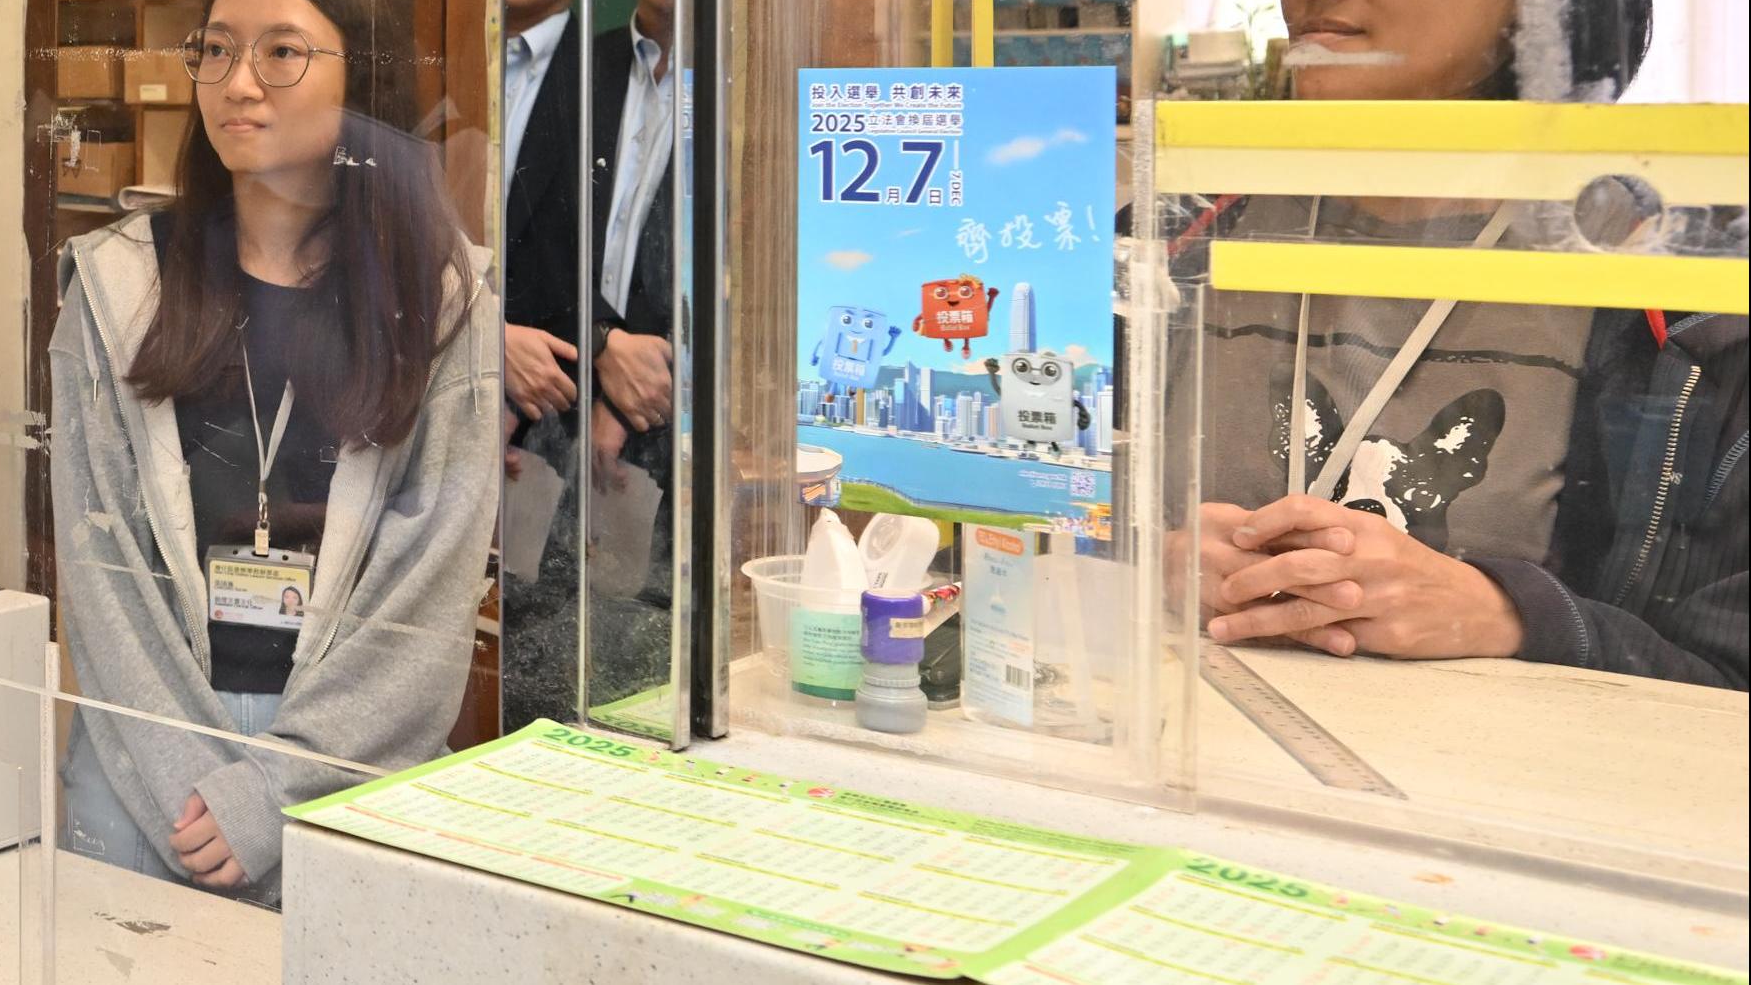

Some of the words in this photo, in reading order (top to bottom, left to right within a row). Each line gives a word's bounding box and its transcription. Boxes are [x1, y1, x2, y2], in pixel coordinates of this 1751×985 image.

[811, 86, 878, 99] 投入選舉
[892, 87, 963, 102] 共創未來
[813, 115, 865, 133] 2025
[868, 116, 962, 126] 立法會換屆選舉
[812, 141, 943, 203] 12月7日
[937, 310, 974, 324] 投票箱
[1018, 409, 1056, 425] 投票箱
[543, 728, 638, 757] 2025
[1186, 857, 1311, 897] 2025
